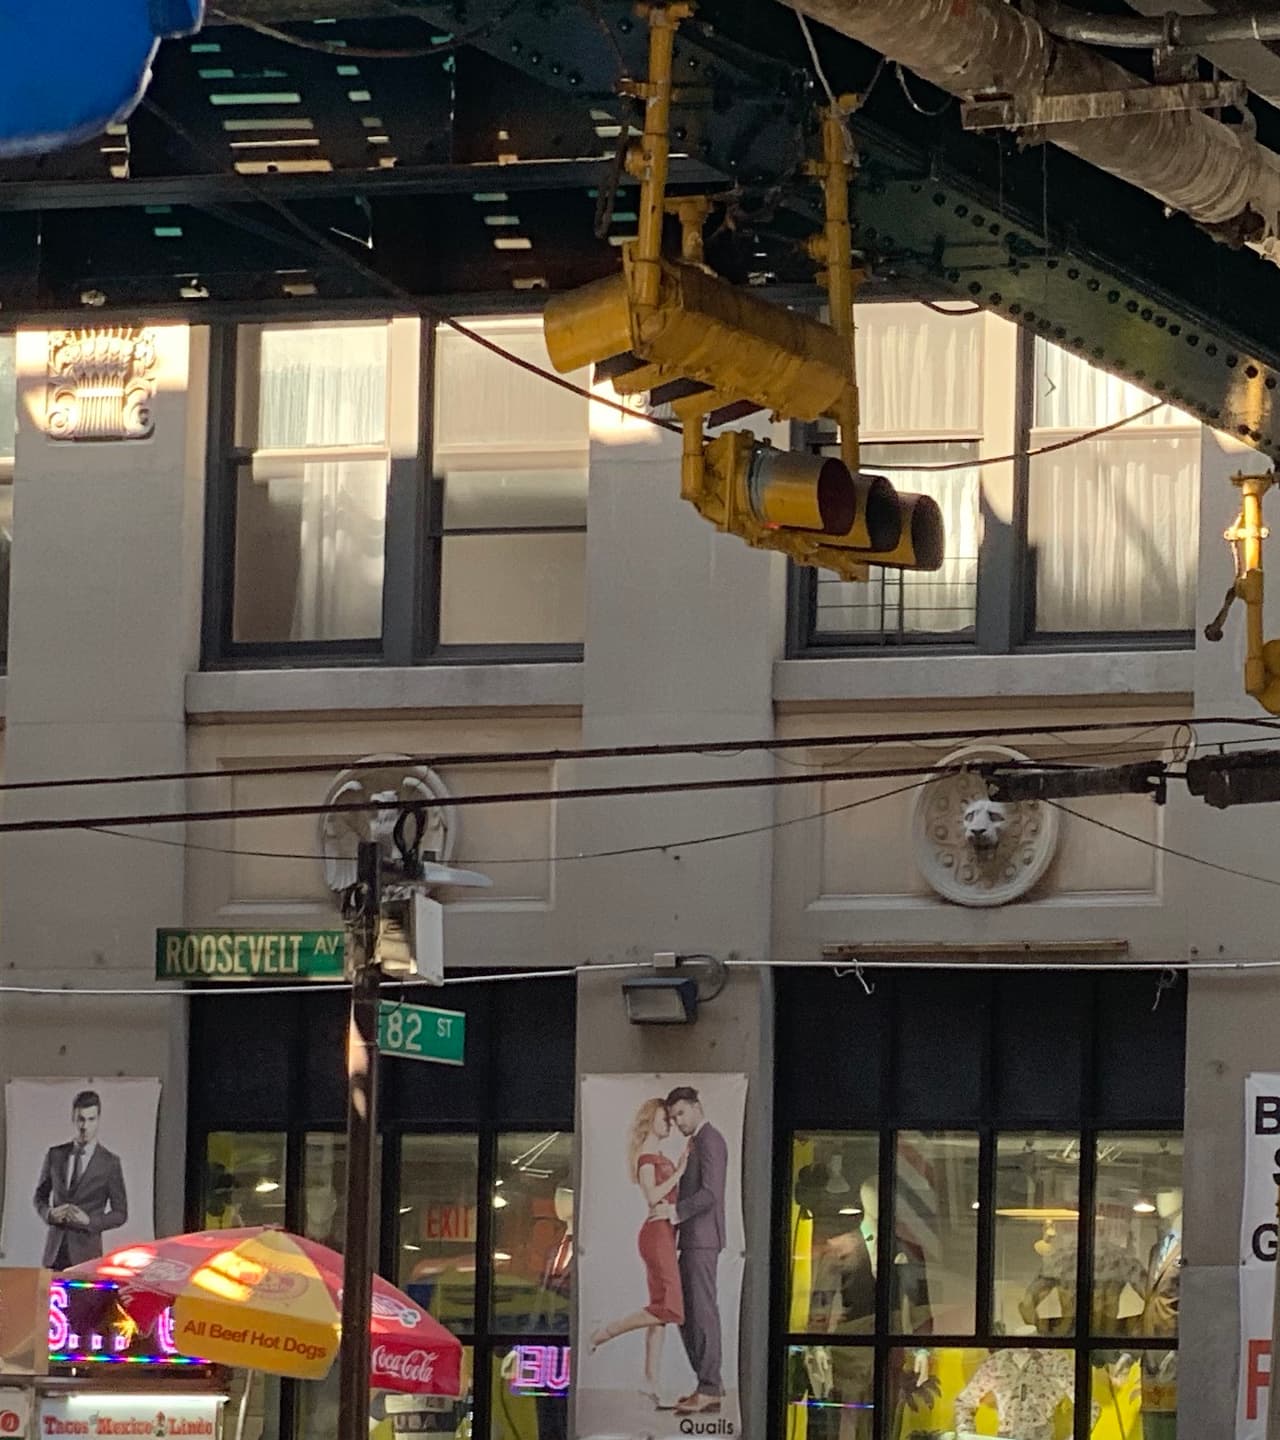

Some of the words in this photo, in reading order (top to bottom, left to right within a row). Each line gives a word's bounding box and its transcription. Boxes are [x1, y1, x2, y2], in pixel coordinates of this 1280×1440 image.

[166, 933, 303, 974] ROOSEVELT
[313, 935, 340, 956] AV
[386, 1010, 422, 1051] 82
[437, 1017, 453, 1038] ST
[426, 1204, 470, 1239] EXIT
[184, 1318, 206, 1337] All
[209, 1325, 249, 1345] Beef
[250, 1331, 281, 1349] Hot
[283, 1336, 328, 1361] Dogs
[43, 1415, 89, 1435] Tacos
[96, 1416, 152, 1435] Mexico
[679, 1418, 735, 1435] Quails
